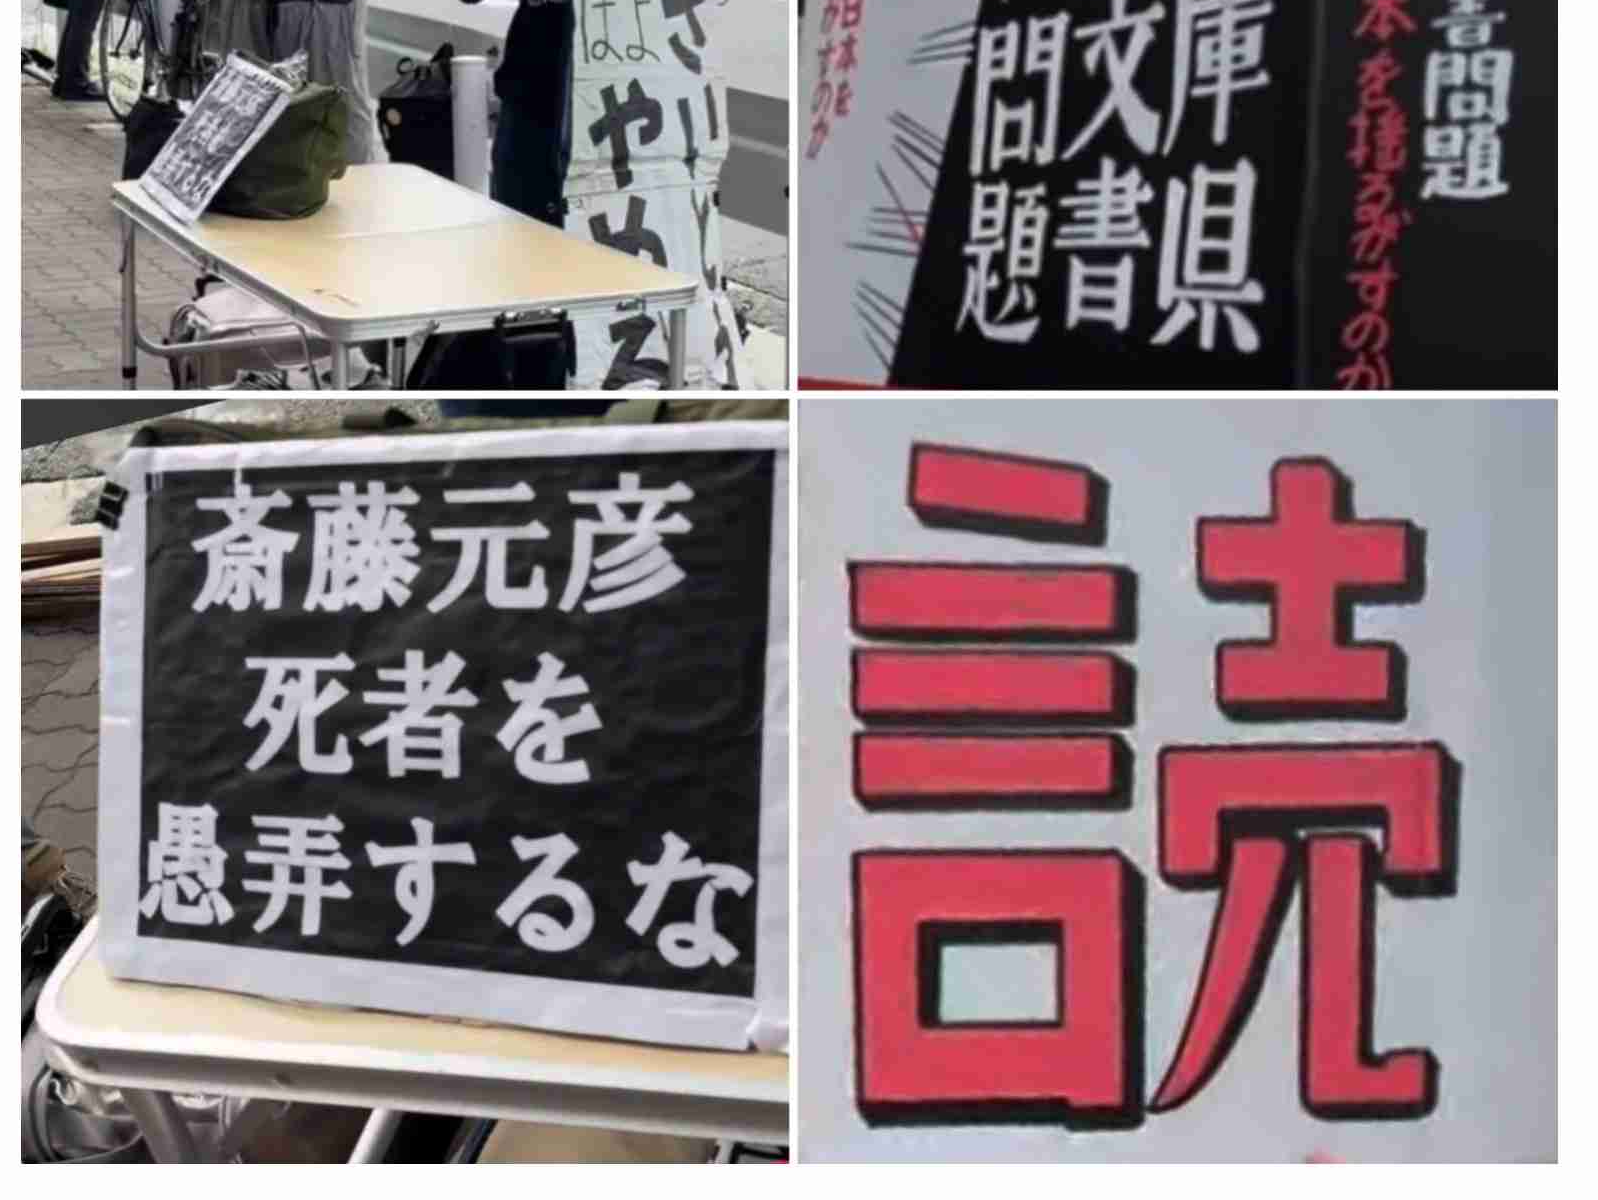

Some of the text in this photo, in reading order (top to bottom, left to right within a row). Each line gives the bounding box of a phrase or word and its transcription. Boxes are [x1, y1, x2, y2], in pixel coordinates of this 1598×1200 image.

[955, 11, 1071, 343] 問題
[192, 472, 695, 614] 斎藤元彦
[244, 649, 603, 784] 死者を
[847, 440, 1462, 1132] 読
[140, 802, 753, 969] 愚弄するな
